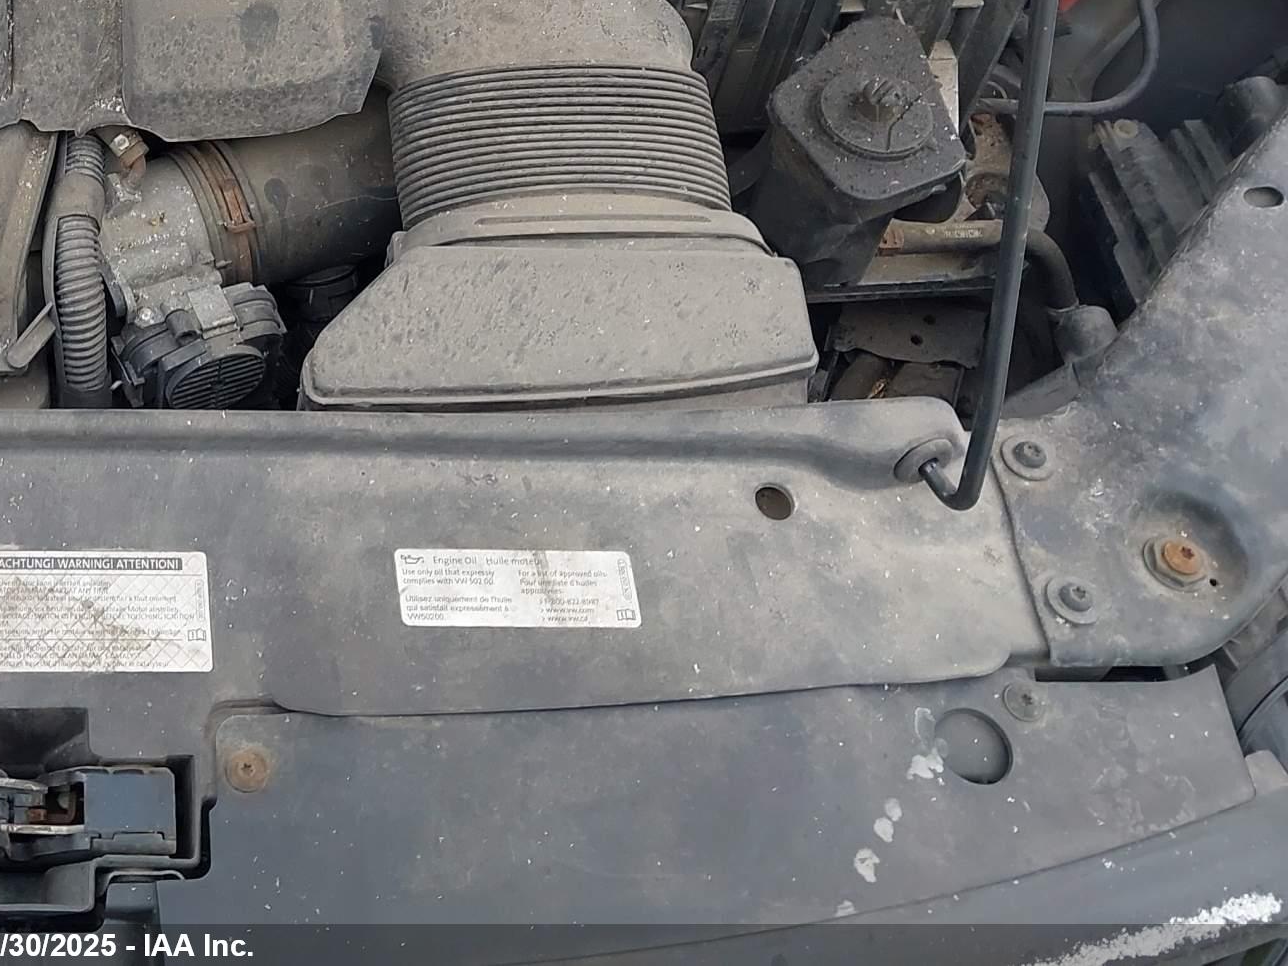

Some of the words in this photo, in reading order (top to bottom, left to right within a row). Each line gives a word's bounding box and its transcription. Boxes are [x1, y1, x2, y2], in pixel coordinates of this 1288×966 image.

[56, 558, 114, 570] WARNING!
[115, 558, 179, 571] ATTENTION!
[433, 556, 463, 566] Engine
[464, 556, 477, 565] Oil
[486, 557, 509, 566] Huile
[417, 568, 433, 577] only
[403, 577, 435, 585] complies
[436, 577, 453, 585] with
